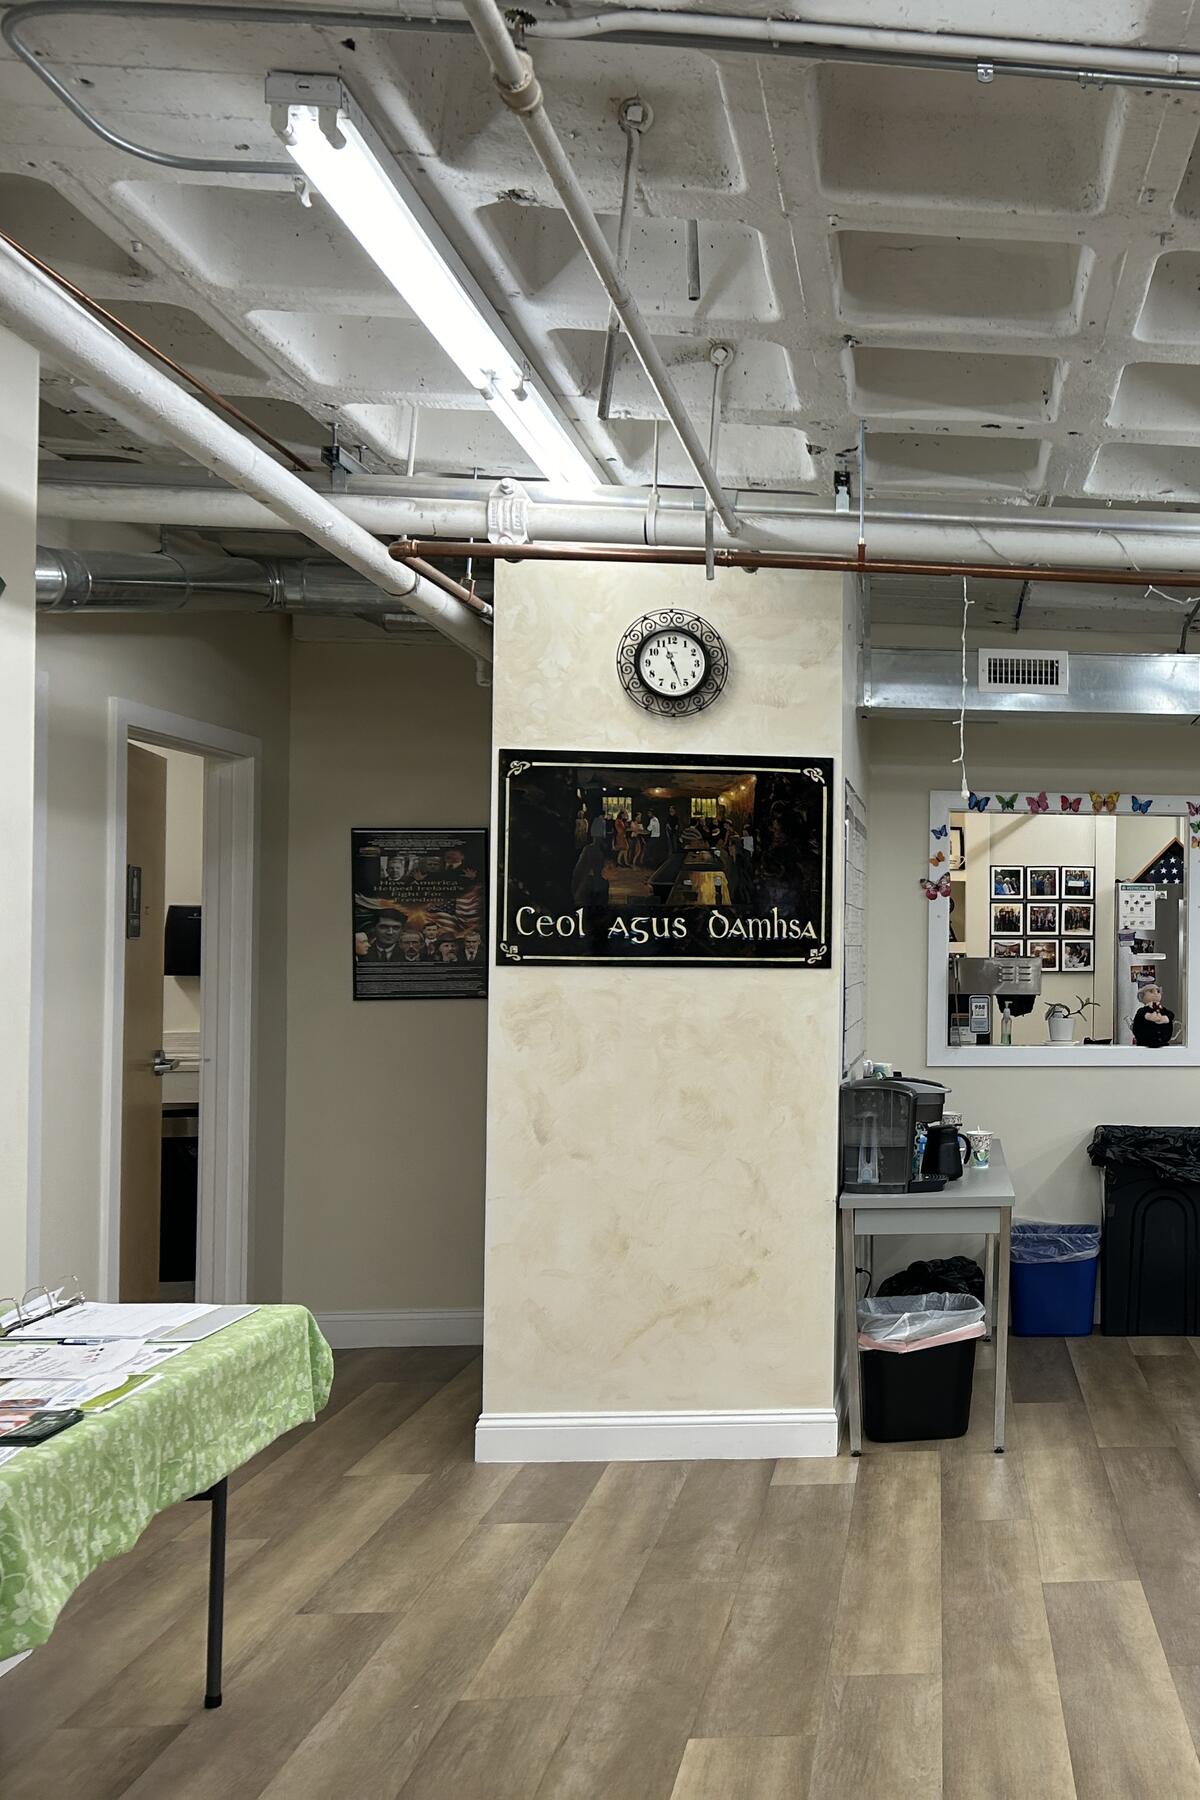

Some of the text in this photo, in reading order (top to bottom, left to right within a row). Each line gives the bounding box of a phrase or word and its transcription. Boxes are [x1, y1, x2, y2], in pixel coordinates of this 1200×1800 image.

[656, 640, 666, 648] 11
[667, 636, 678, 645] 12
[683, 640, 687, 648] 1
[648, 648, 659, 656] 10
[691, 648, 696, 656] 2
[645, 659, 651, 667] 9
[694, 660, 700, 668] 3
[649, 670, 655, 678] 8
[658, 678, 664, 686] 7
[670, 682, 676, 690] 6
[683, 678, 688, 686] 5
[515, 906, 586, 938] Ceol
